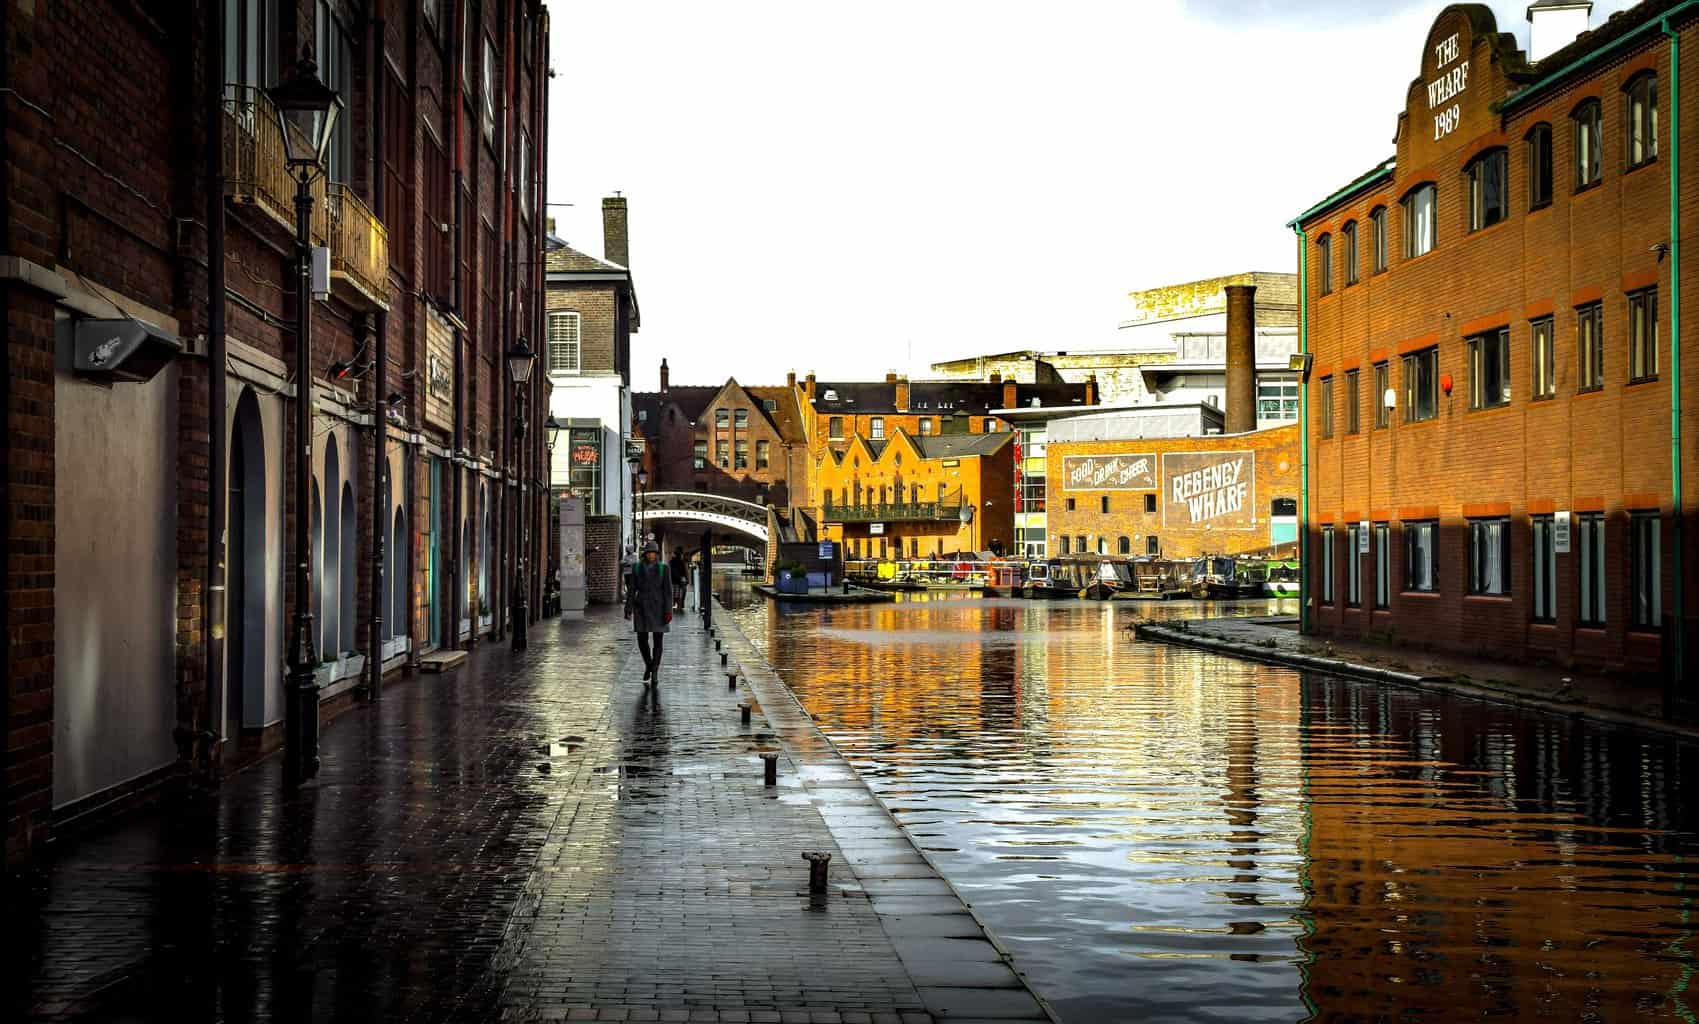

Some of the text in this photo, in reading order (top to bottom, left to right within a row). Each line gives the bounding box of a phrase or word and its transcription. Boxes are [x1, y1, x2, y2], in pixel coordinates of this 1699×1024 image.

[1435, 32, 1460, 69] THE
[1427, 60, 1469, 110] WHARF
[1433, 103, 1460, 141] 1989
[1173, 457, 1243, 503] REGENCY
[1188, 482, 1247, 524] WHARF
